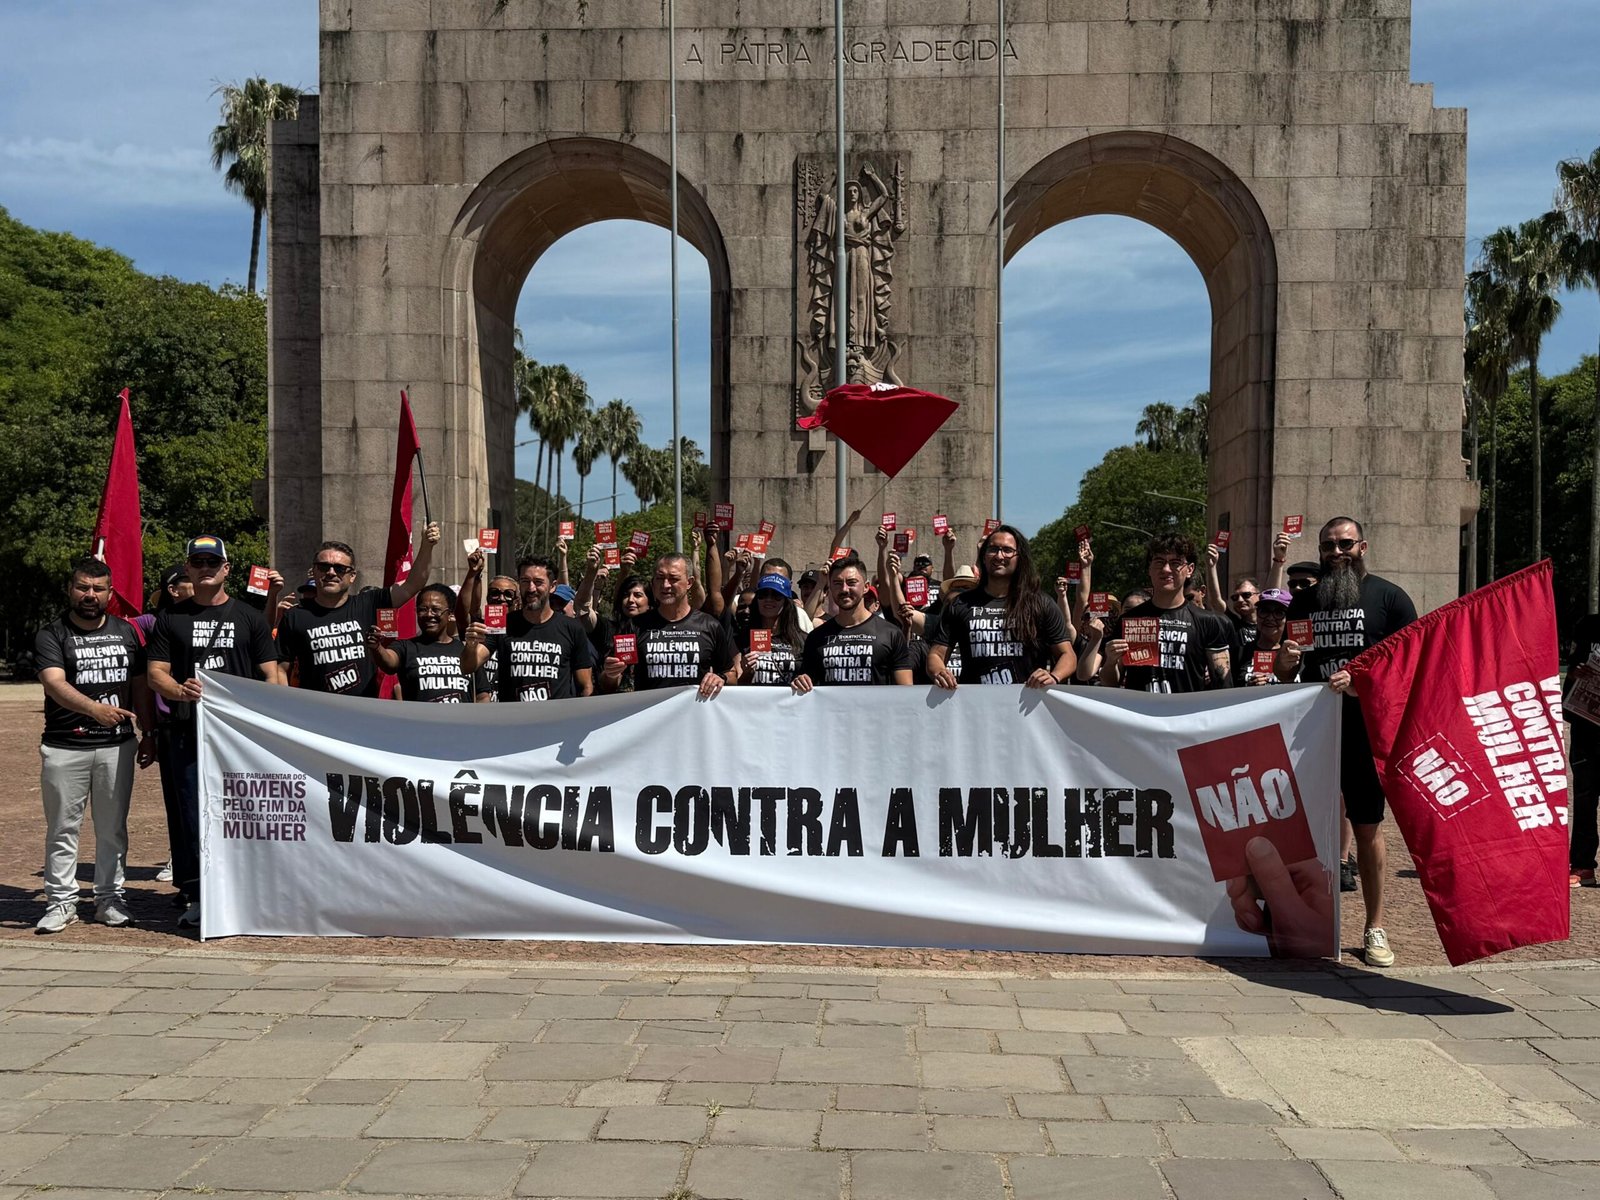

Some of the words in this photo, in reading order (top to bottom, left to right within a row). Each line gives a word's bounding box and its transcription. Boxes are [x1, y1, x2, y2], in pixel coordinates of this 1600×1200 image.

[686, 43, 703, 65] A
[193, 629, 225, 638] CONTA
[307, 620, 362, 639] VIOLÊNCIA
[1312, 620, 1351, 632] ONTRA
[1356, 620, 1364, 630] A
[192, 637, 234, 648] MUHER
[310, 634, 354, 650] CONTRA
[356, 632, 364, 642] A
[510, 640, 562, 655] VIOLÊNCIA
[646, 640, 700, 652] VIOLÊNCIA
[75, 645, 128, 659] VIOLÊNCIA
[313, 645, 365, 665] MULHER
[823, 643, 873, 657] VIOLÊNCIA
[1179, 643, 1186, 655] A
[76, 656, 118, 670] CONTRA
[122, 656, 129, 667] A
[510, 652, 550, 663] CONTRA
[553, 655, 560, 665] A
[646, 653, 688, 664] CONTRA
[692, 653, 700, 664] A
[822, 656, 861, 668] CONTRA
[865, 656, 872, 667] A
[76, 668, 127, 684] MULHER
[418, 665, 462, 675] CONTRA
[510, 664, 559, 679] MULHER
[647, 664, 698, 678] MULHER
[824, 668, 872, 682] MULHER
[330, 669, 357, 690] NÃO
[419, 676, 470, 692] MULHER
[1503, 681, 1568, 794] CONTRA
[1462, 690, 1554, 832] MULHER
[1412, 747, 1470, 806] NÃO
[223, 780, 306, 798] HOMENS
[223, 798, 254, 812] PELO
[259, 800, 283, 812] FIM
[288, 800, 306, 813] DA
[1196, 764, 1296, 832] NÃO
[266, 814, 298, 822] CONTRA
[301, 814, 307, 823] A
[326, 770, 615, 853] VIOLÊNCIA
[634, 785, 864, 858] CONTRA
[881, 787, 920, 858] A
[938, 787, 1178, 860] MULHER
[223, 821, 306, 841] MULHER
